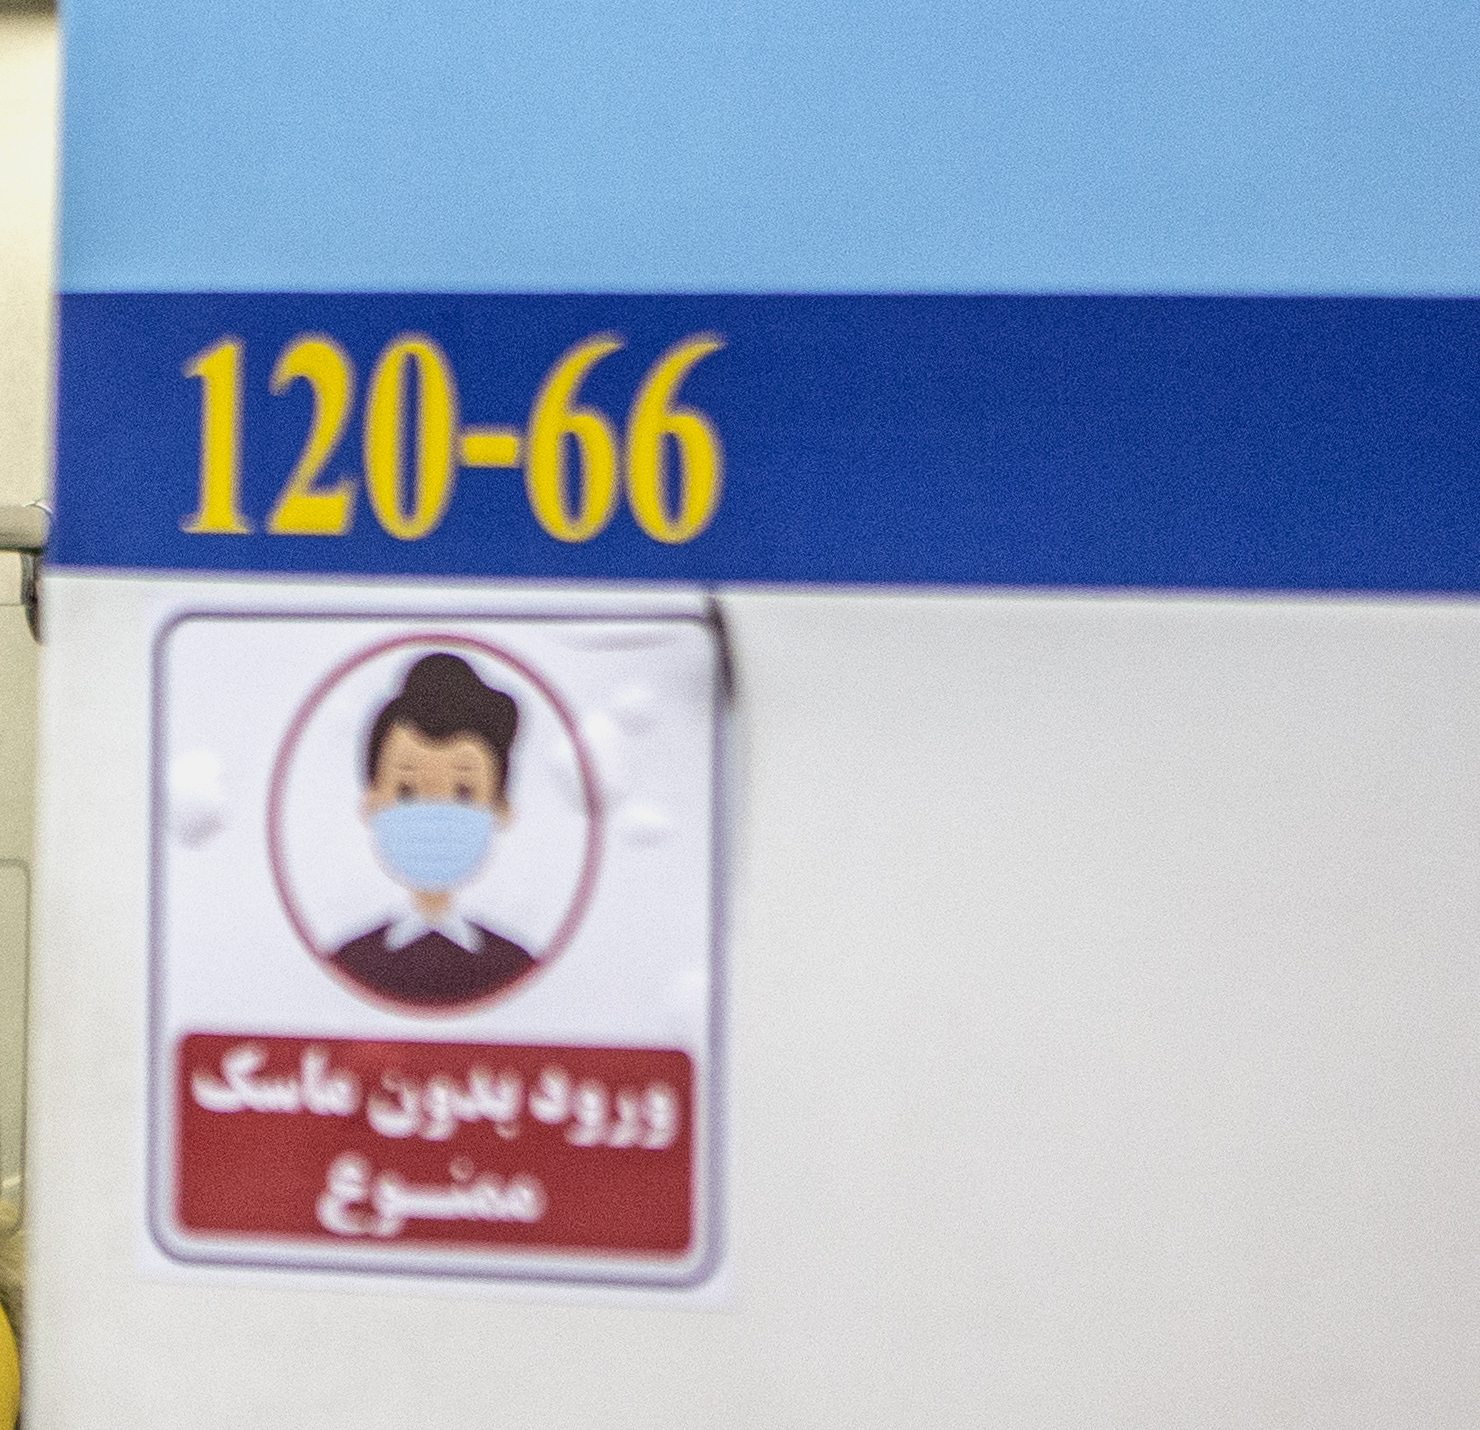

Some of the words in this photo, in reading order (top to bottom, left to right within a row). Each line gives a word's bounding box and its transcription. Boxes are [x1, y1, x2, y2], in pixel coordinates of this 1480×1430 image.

[180, 331, 726, 543] 120-66
[192, 1045, 358, 1115] ماسک
[367, 1067, 521, 1140] بدون
[530, 1065, 676, 1150] ورود
[317, 1153, 541, 1237] ممنوع
